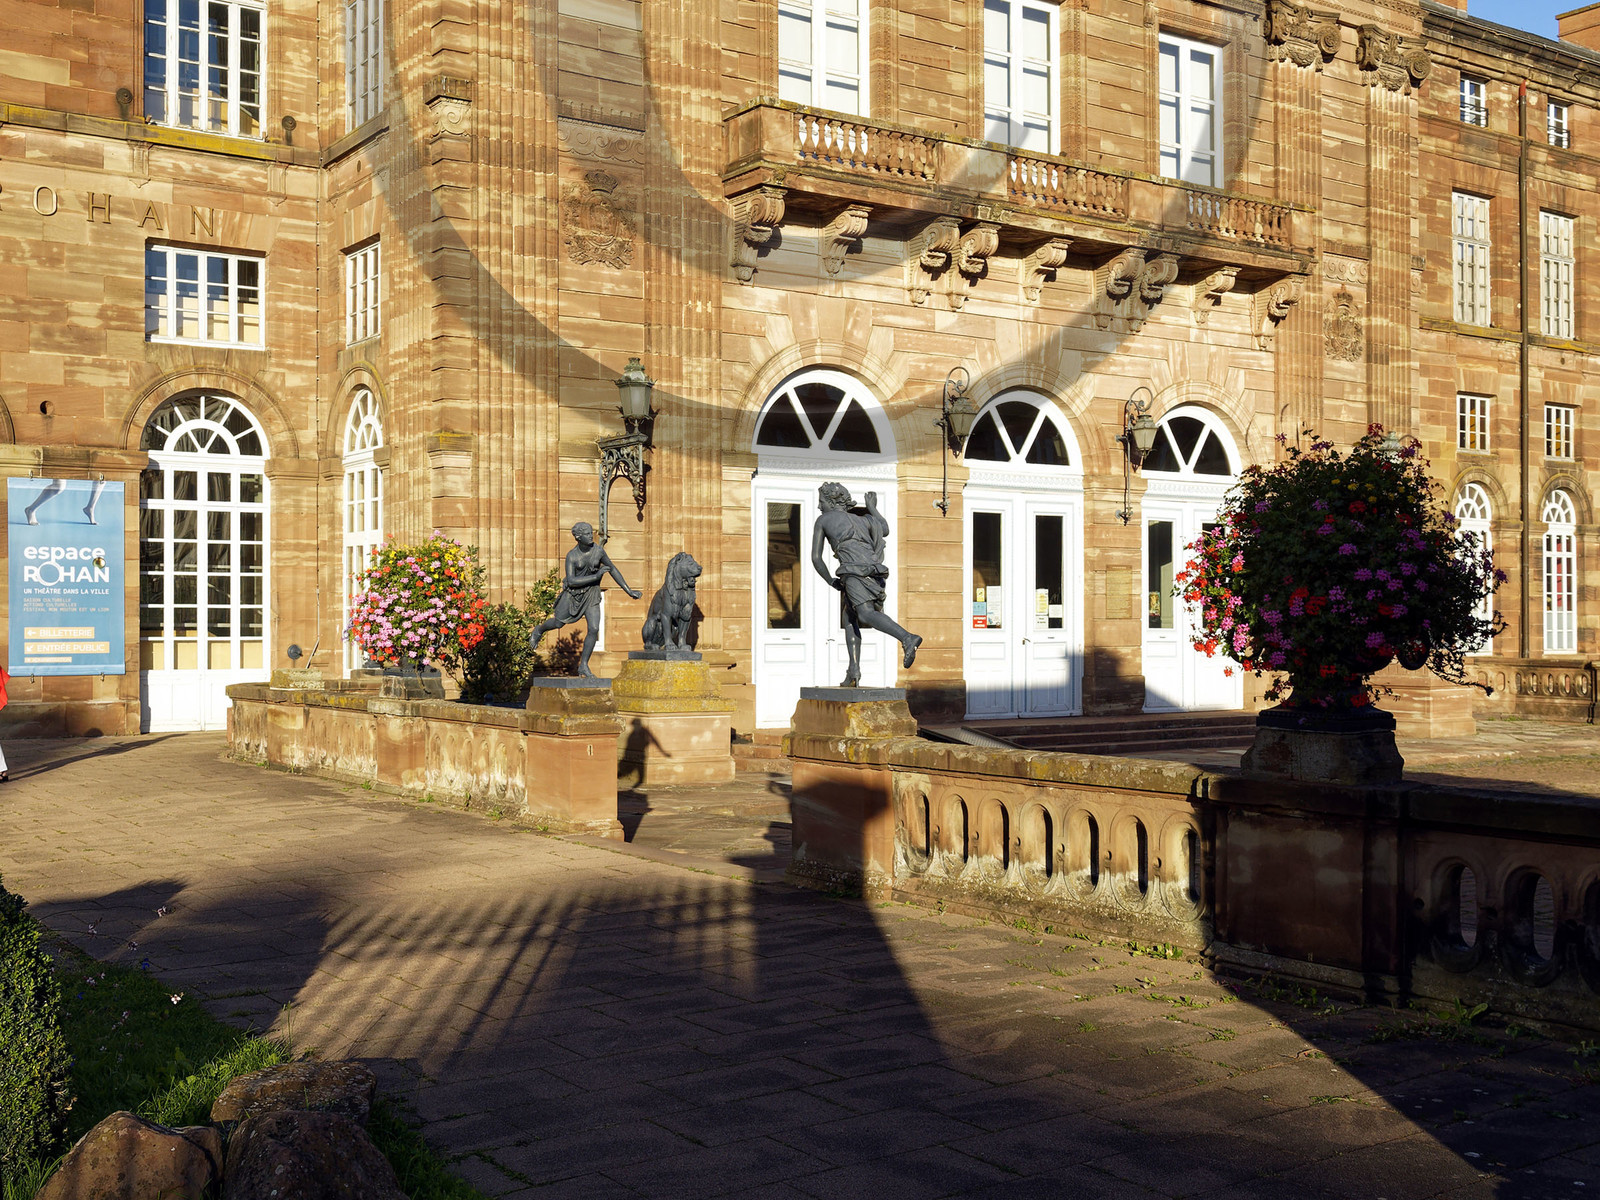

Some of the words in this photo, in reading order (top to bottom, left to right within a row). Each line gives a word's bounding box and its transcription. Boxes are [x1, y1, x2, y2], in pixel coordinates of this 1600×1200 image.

[0, 183, 215, 237] OHAN
[23, 545, 106, 562] espace
[23, 561, 110, 586] ROHAN
[39, 629, 92, 637] BILLETTERIE
[37, 643, 71, 652] ENTRÉE
[73, 644, 105, 652] PUBLIC
